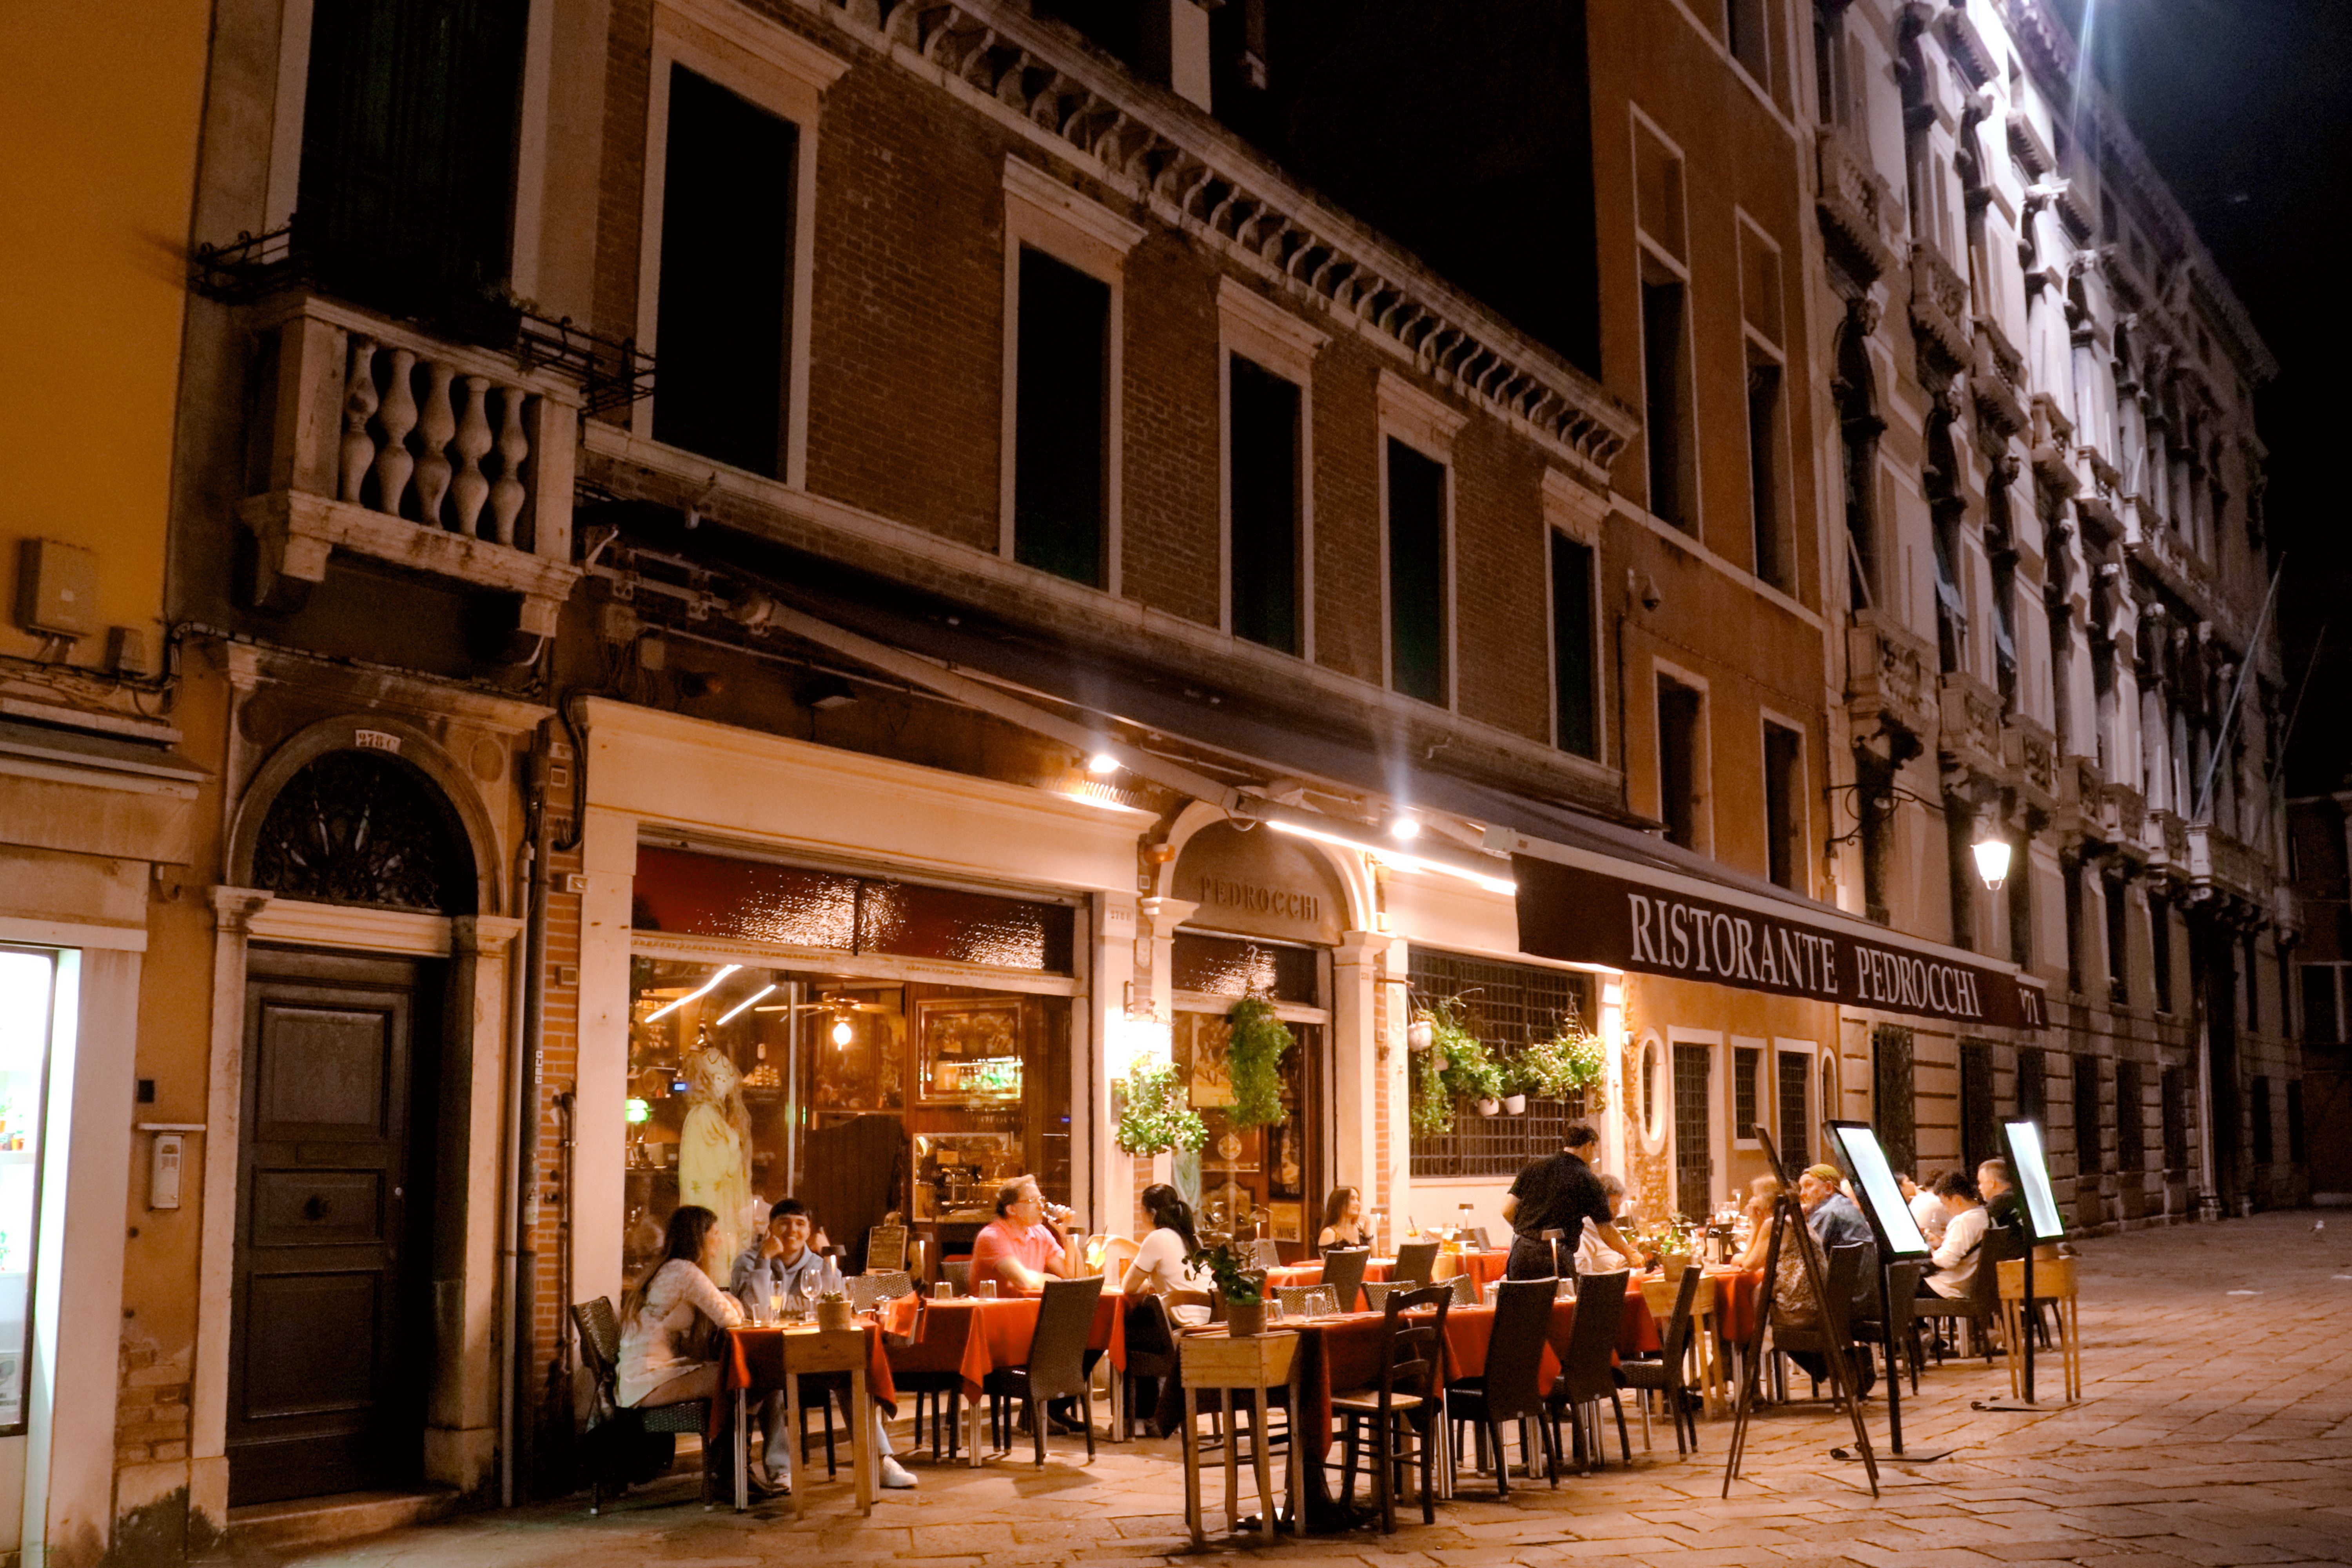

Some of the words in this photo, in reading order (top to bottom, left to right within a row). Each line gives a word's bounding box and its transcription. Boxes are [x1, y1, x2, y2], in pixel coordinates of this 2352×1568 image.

[358, 733, 383, 748] 278
[1200, 877, 1319, 923] PEDROCCHI
[1628, 893, 1838, 995] RISTORANTE
[1855, 946, 1983, 1018] PEDROCCHI
[1276, 1226, 1297, 1240] WINE
